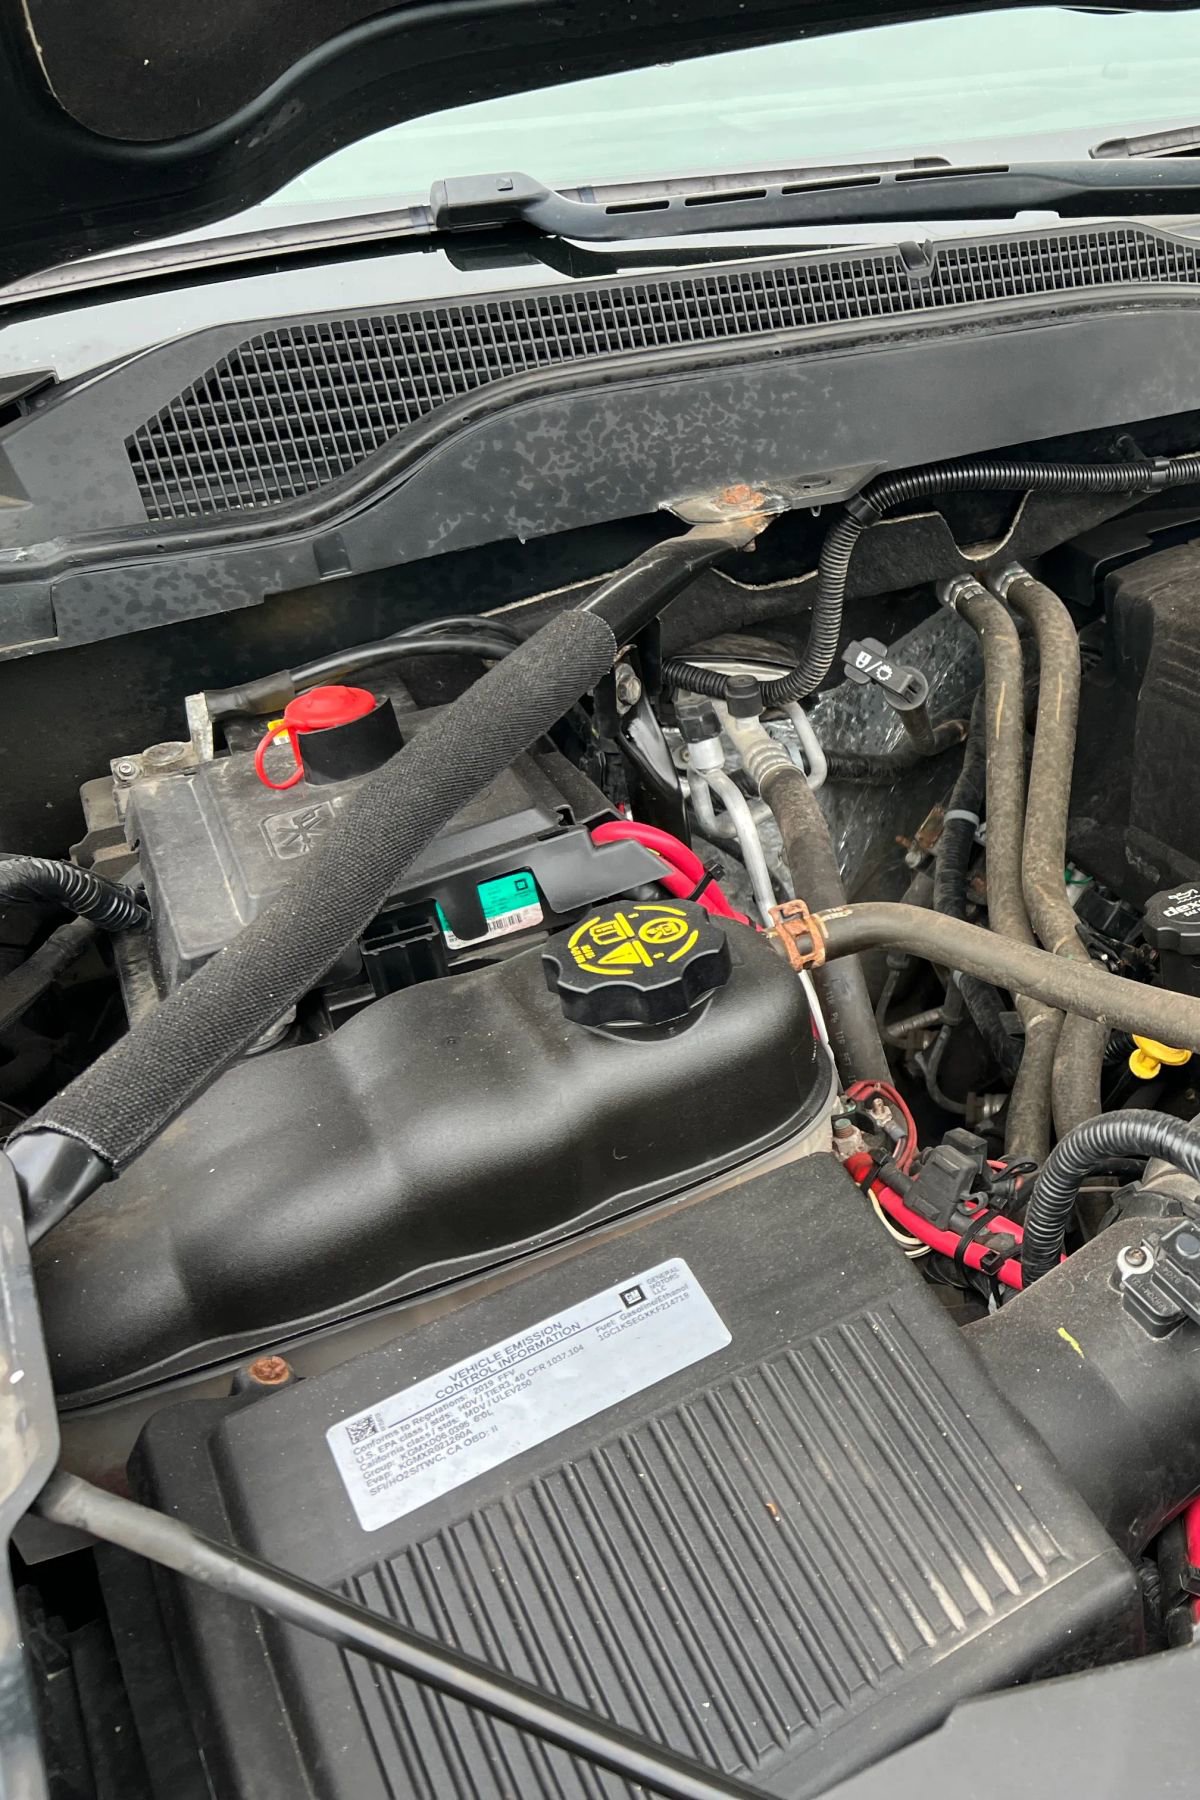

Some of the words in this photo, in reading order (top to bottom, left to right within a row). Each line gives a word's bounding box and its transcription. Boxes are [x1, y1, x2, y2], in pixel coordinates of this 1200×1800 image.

[646, 1265, 680, 1285] GENERAL
[648, 1271, 679, 1290] MOTORS
[652, 1284, 667, 1295] LLC
[434, 1363, 496, 1400] CONTROL
[497, 1321, 581, 1368] INFORMATION
[448, 1350, 503, 1383] VEHICLE
[503, 1321, 562, 1355] EMISSION
[352, 1427, 399, 1456] Conforms
[400, 1421, 411, 1432] to
[411, 1392, 468, 1427] Regulations:
[472, 1379, 494, 1394] 2019
[497, 1368, 515, 1382] FFV
[355, 1449, 376, 1464] U.S.
[377, 1438, 397, 1453] EPA
[398, 1425, 423, 1442] class
[429, 1410, 452, 1426] stds:
[513, 1372, 526, 1383] 40
[526, 1362, 546, 1377] CFR
[546, 1343, 584, 1366] 1037.104
[359, 1444, 404, 1472] California
[405, 1430, 431, 1448] class
[437, 1415, 460, 1432] stds:
[464, 1402, 486, 1418] MDV
[491, 1378, 532, 1403] ULEV250
[446, 1443, 462, 1456] CA
[362, 1458, 395, 1480] Group:
[365, 1468, 393, 1488] Evap:
